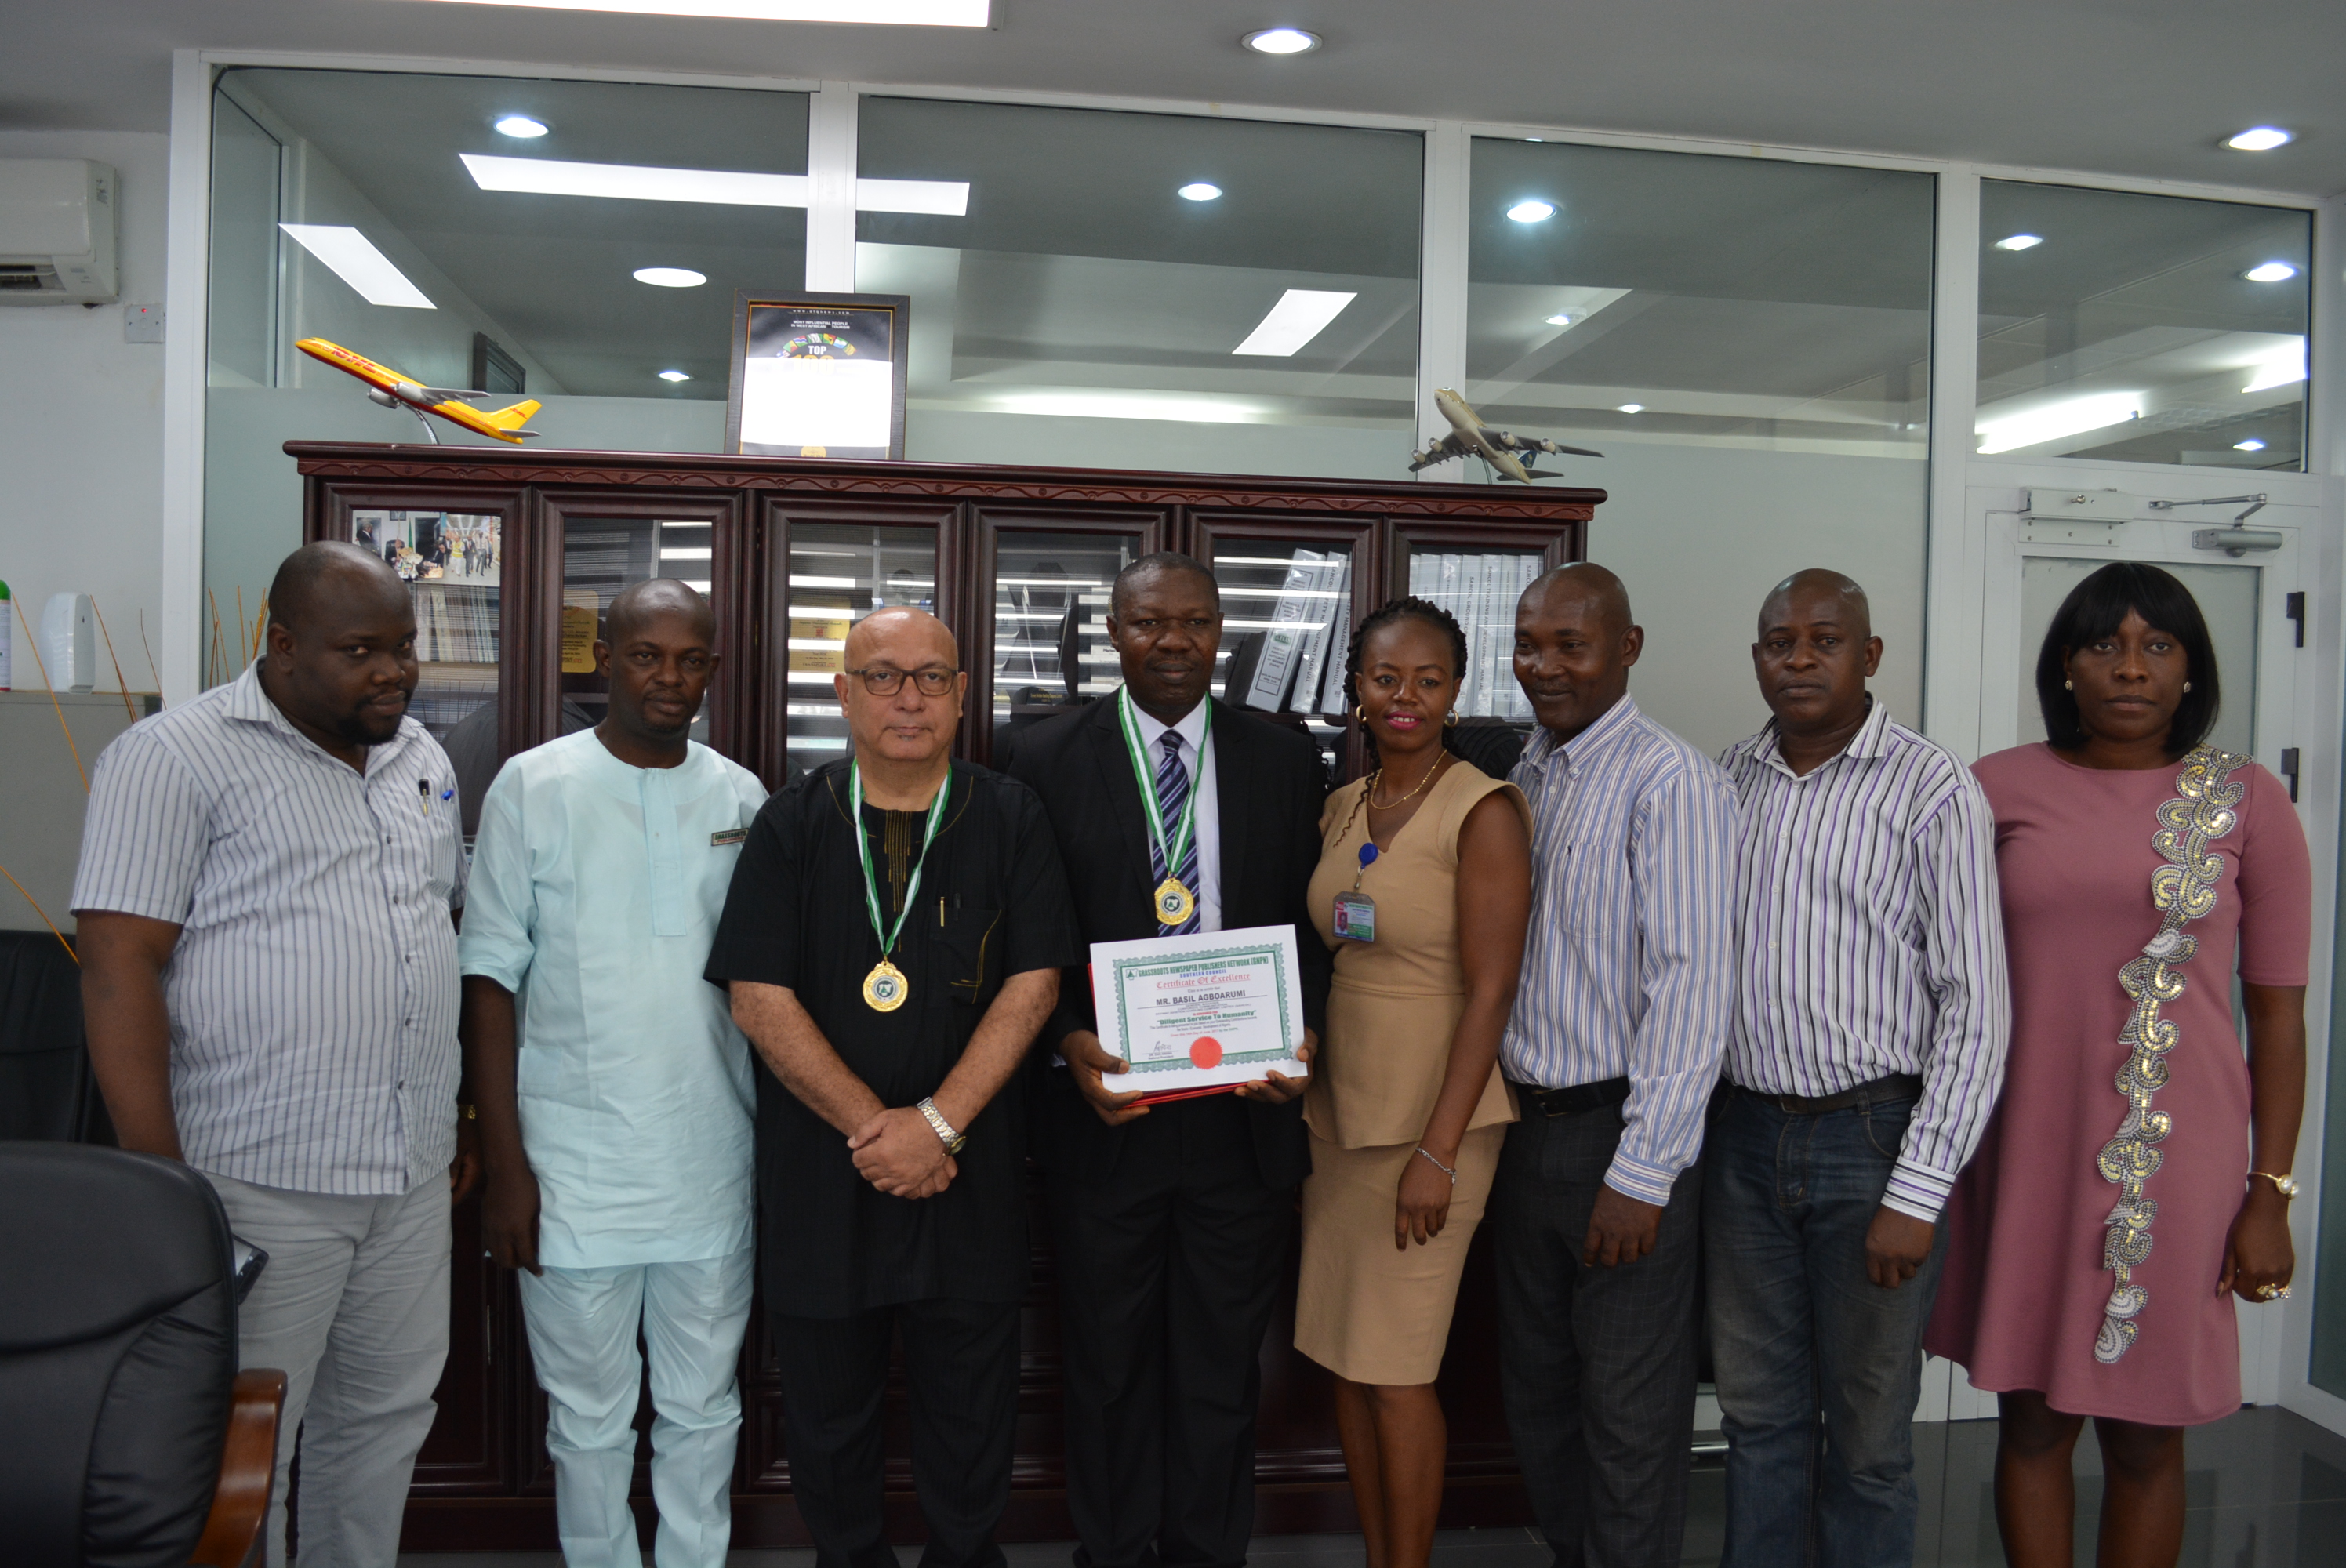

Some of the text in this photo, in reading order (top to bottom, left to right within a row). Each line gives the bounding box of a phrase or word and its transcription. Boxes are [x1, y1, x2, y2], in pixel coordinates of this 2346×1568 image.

[808, 346, 826, 354] TOP
[331, 347, 375, 373] DHL
[1337, 616, 1349, 660] MANAGEMENT
[1306, 658, 1315, 682] MANUAL
[715, 830, 746, 840] GRASSROOTS
[1138, 967, 1168, 977] GRASSROOTS
[1170, 964, 1197, 974] NEWSPAPER
[1198, 961, 1226, 971] PUBLISHERS
[1227, 959, 1250, 967] NETWORK
[1157, 978, 1195, 989] Certificate
[1211, 974, 1250, 983] Excellence
[1198, 990, 1245, 1001] AGBOARUMI
